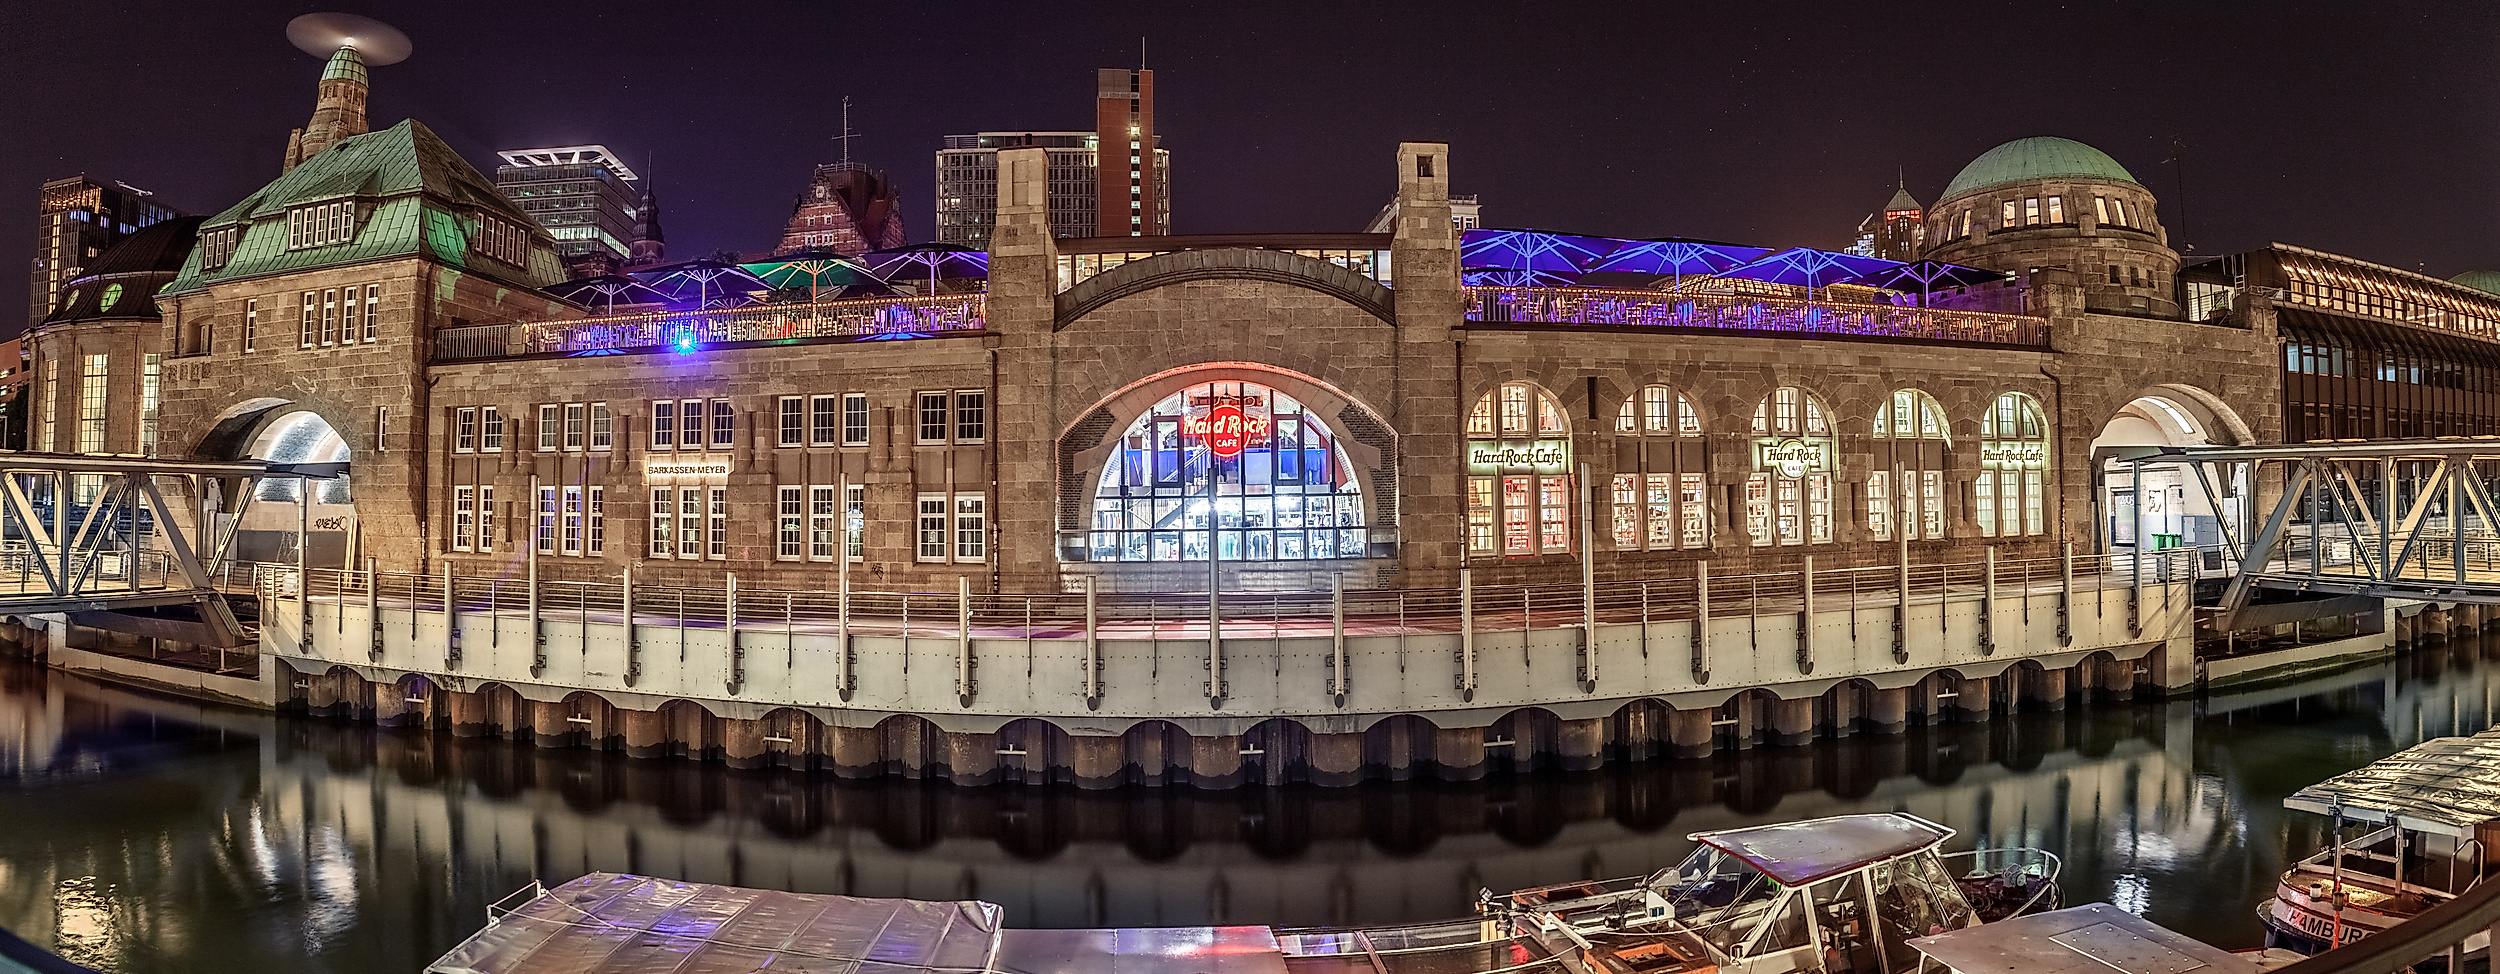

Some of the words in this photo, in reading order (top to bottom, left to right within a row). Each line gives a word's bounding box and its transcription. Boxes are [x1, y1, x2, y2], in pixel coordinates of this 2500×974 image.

[1183, 415, 1226, 435] Hard
[1227, 415, 1268, 437] Rock
[1216, 439, 1237, 447] CAFE
[1473, 449, 1505, 464] Hard
[1506, 448, 1534, 466] Rock
[1535, 448, 1563, 466] Cafe
[1767, 448, 1795, 461] Hard
[1796, 448, 1821, 463] Rock
[1982, 449, 2004, 461] Hard
[2005, 449, 2025, 463] Rock
[2025, 449, 2044, 463] Cafe
[2288, 908, 2377, 944] HAMBUR
